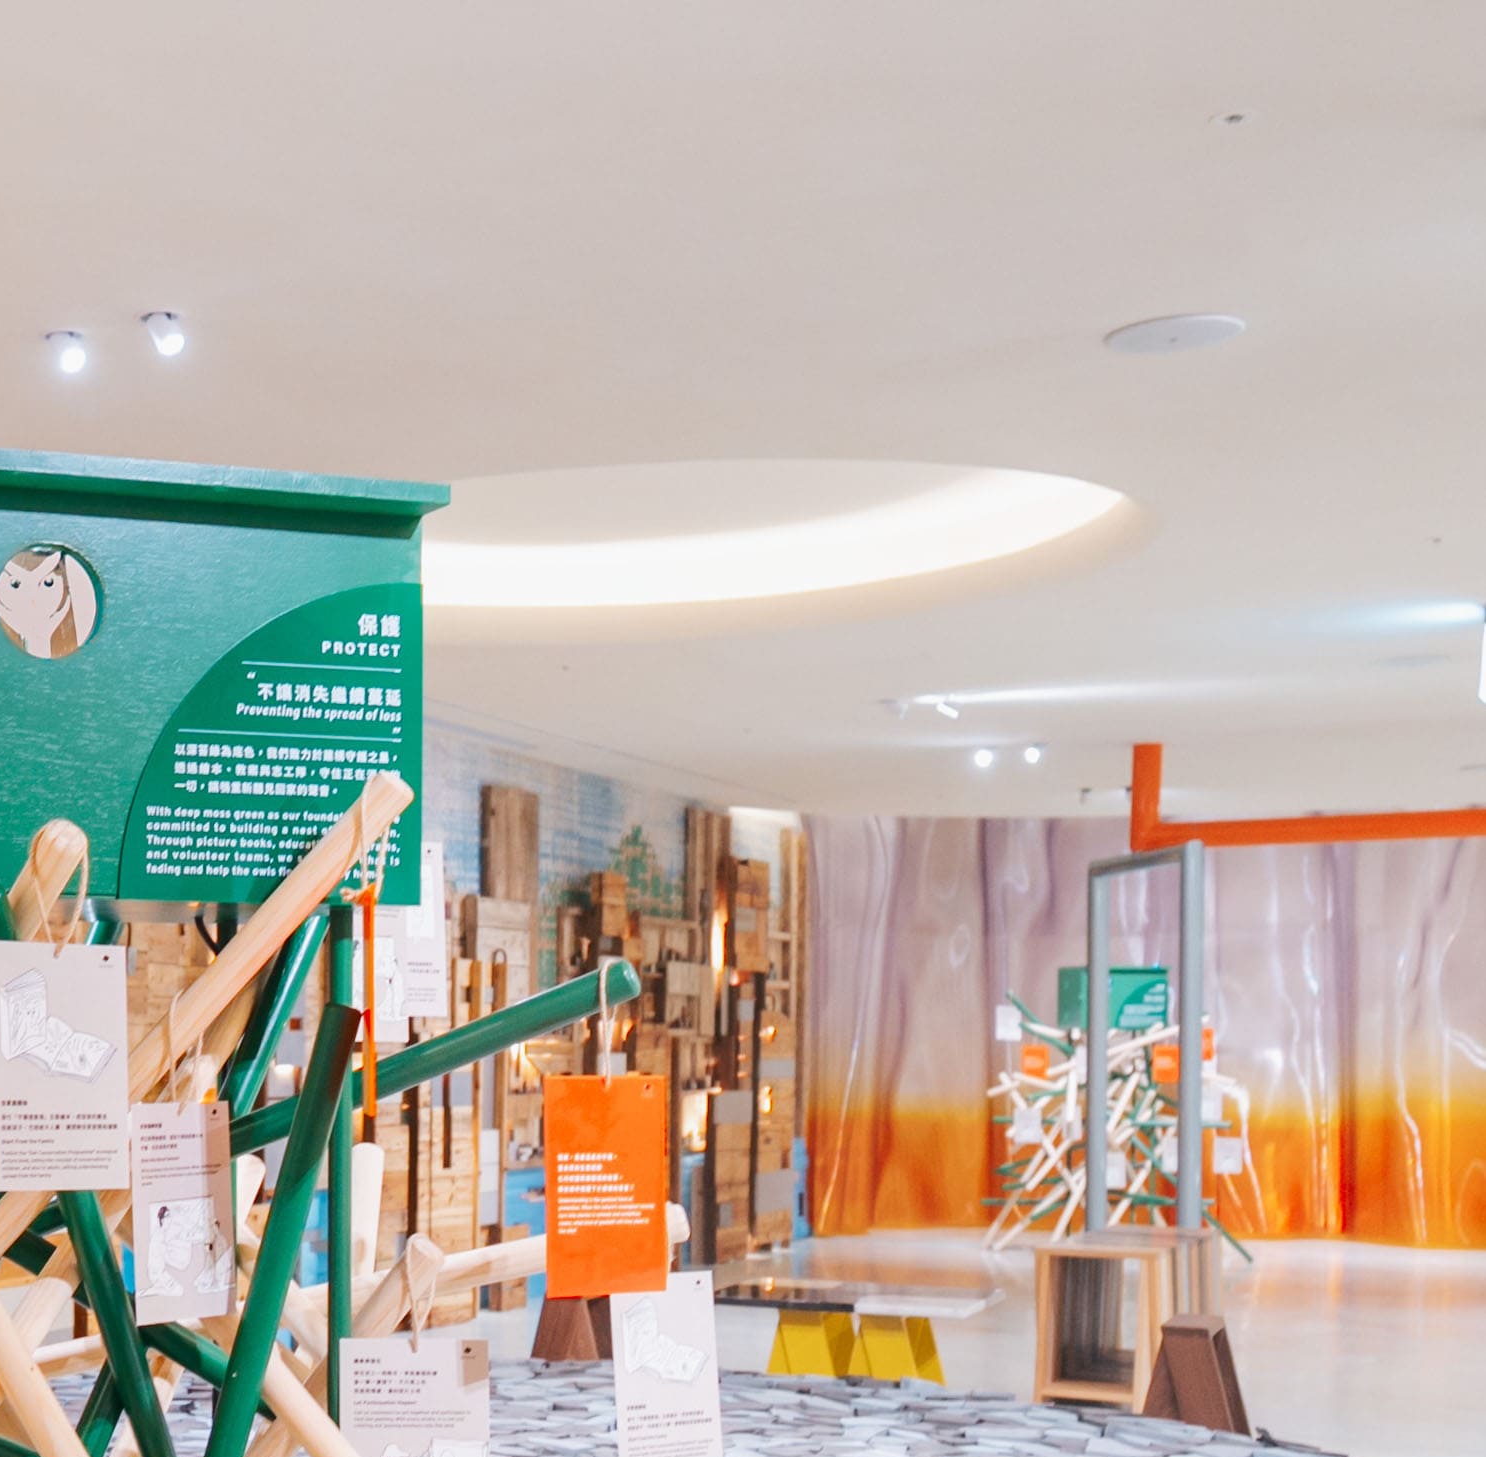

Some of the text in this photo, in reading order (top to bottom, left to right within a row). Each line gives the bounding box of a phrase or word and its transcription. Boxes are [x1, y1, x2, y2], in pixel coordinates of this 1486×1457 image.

[357, 613, 401, 637] 保護
[321, 640, 401, 657] PROTECT
[257, 682, 402, 707] 不讓消失繼續蔓延
[235, 701, 401, 723] Preventing the spread of loss
[146, 805, 171, 816] With
[173, 806, 200, 819] deep
[202, 808, 231, 818] moss
[233, 809, 264, 821] green
[266, 811, 279, 820] as
[281, 811, 300, 820] our
[146, 819, 209, 832] committed
[213, 821, 226, 832] to
[229, 821, 278, 836] building
[281, 825, 288, 834] a
[291, 824, 317, 835] nest
[146, 833, 193, 848] Through
[196, 835, 237, 849] picture
[239, 836, 275, 849] books,
[145, 848, 168, 859] and
[171, 848, 230, 861] volunteer
[233, 850, 273, 863] teams,
[277, 854, 292, 862] we
[389, 855, 400, 866] is
[145, 862, 181, 876] fading
[183, 863, 203, 875] and
[205, 863, 229, 877] help
[231, 864, 250, 876] the
[251, 865, 276, 876] owls
